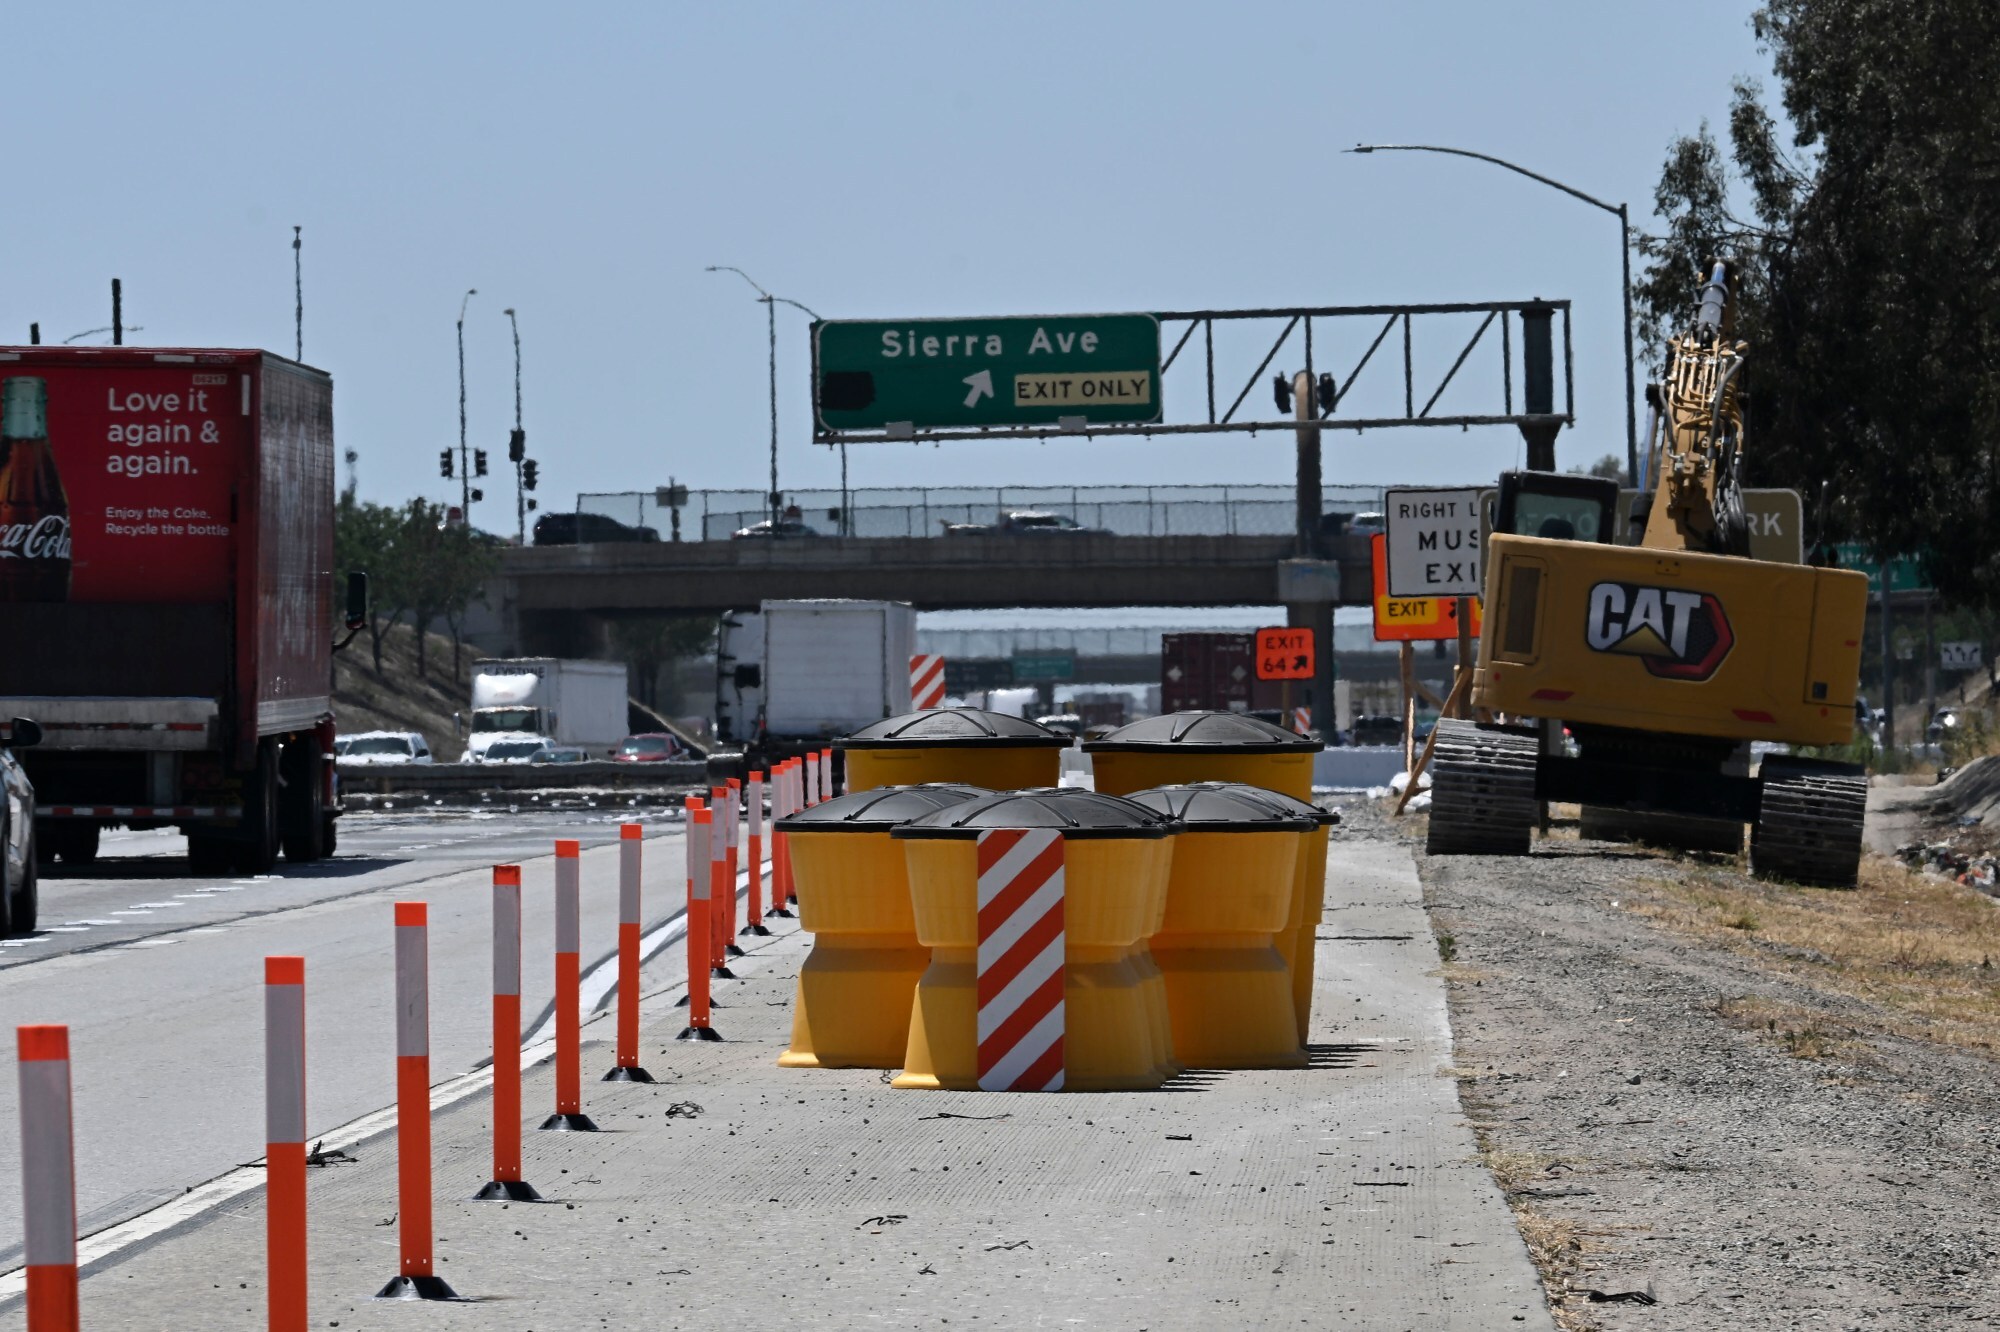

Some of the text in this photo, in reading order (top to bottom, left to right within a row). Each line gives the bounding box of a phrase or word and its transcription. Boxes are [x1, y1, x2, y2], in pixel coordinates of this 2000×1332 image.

[881, 327, 1099, 357] Sierra Ave
[1017, 378, 1146, 399] EXIT ONLY
[109, 387, 208, 412] Love it
[107, 419, 219, 447] again &
[107, 450, 198, 478] again.
[105, 506, 211, 520] Enjoy the Coke.
[1400, 502, 1457, 518] RIGHT
[105, 523, 229, 536] Recycle the bottle
[1418, 530, 1478, 551] MUS
[1426, 562, 1476, 583] EXI
[1388, 601, 1428, 617] EXIT
[1587, 583, 1701, 659] CAT
[1265, 636, 1304, 649] EXIT
[1263, 657, 1286, 672] 64
